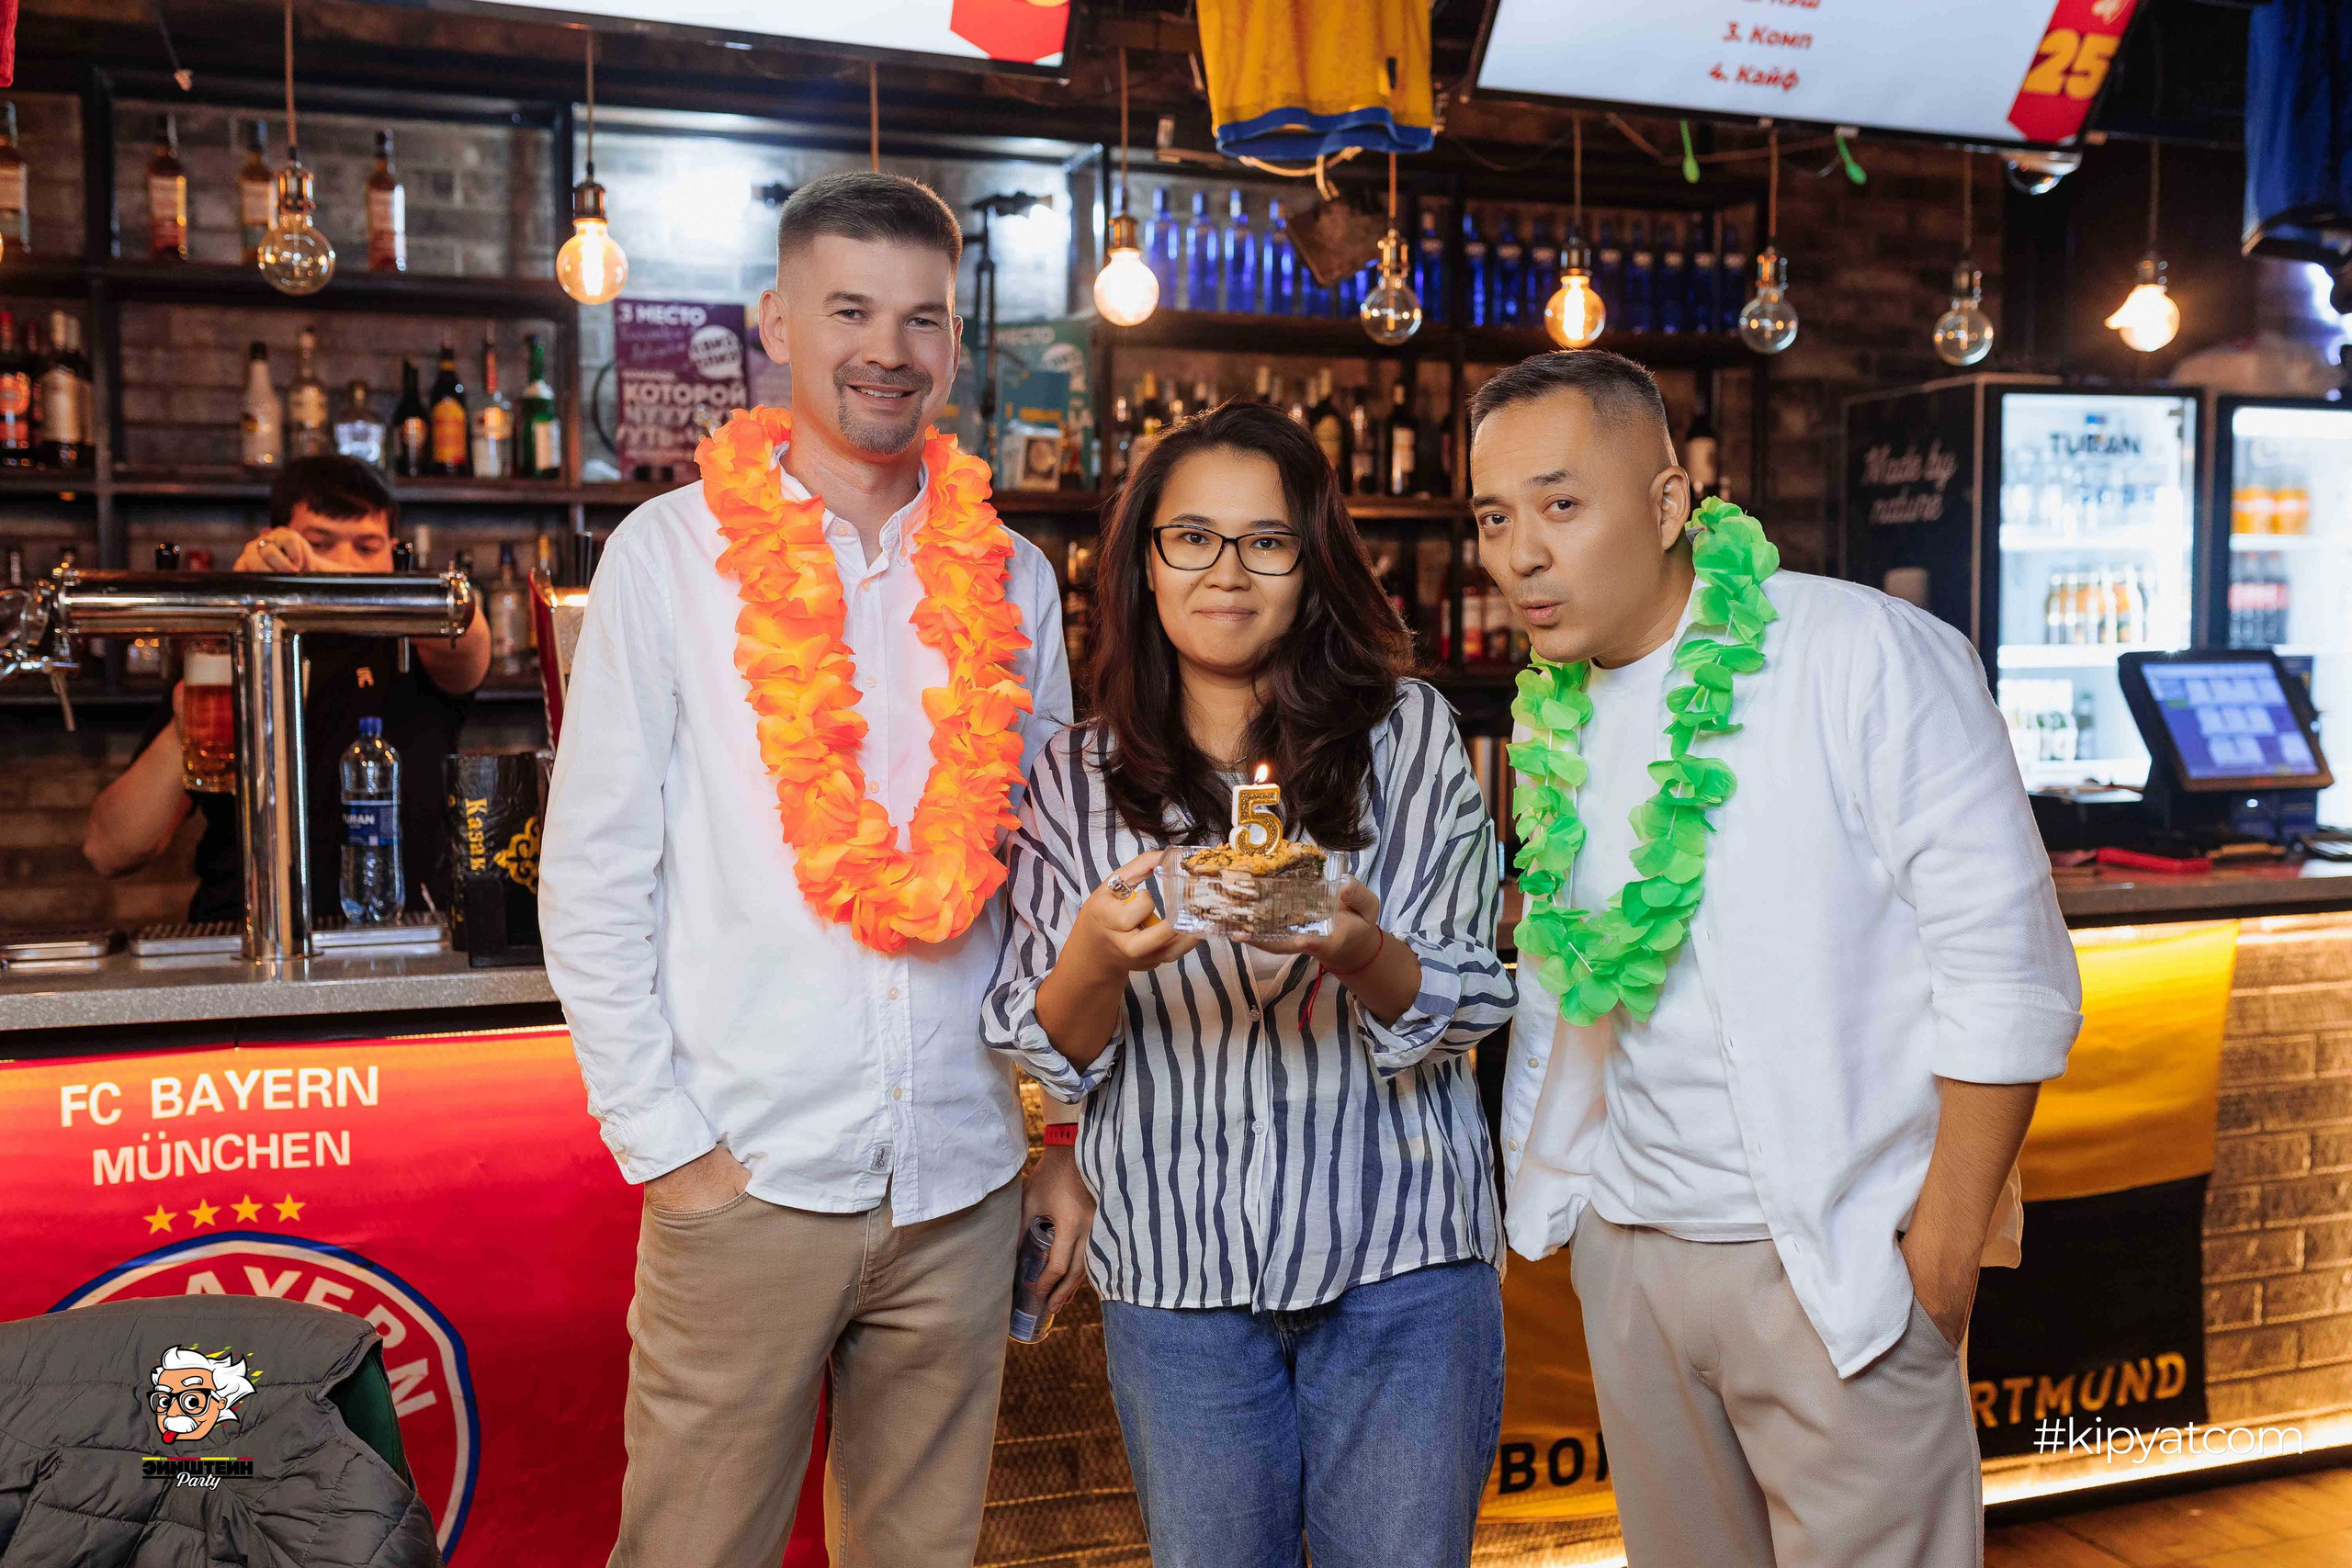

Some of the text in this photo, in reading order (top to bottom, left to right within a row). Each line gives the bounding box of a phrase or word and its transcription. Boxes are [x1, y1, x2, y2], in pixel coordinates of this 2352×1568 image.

[1749, 25, 1814, 50] Комп
[1736, 63, 1800, 92] Кайф
[2023, 28, 2120, 99] 25
[635, 304, 707, 328] МЕСТО
[622, 379, 748, 409] КОТОРОЙ
[2050, 432, 2143, 455] TURAN
[1228, 784, 1283, 856] 5
[60, 1065, 379, 1128] FC BAYERN
[92, 1130, 351, 1186] MÜNCHEN
[1972, 1350, 2188, 1429] RTMUND
